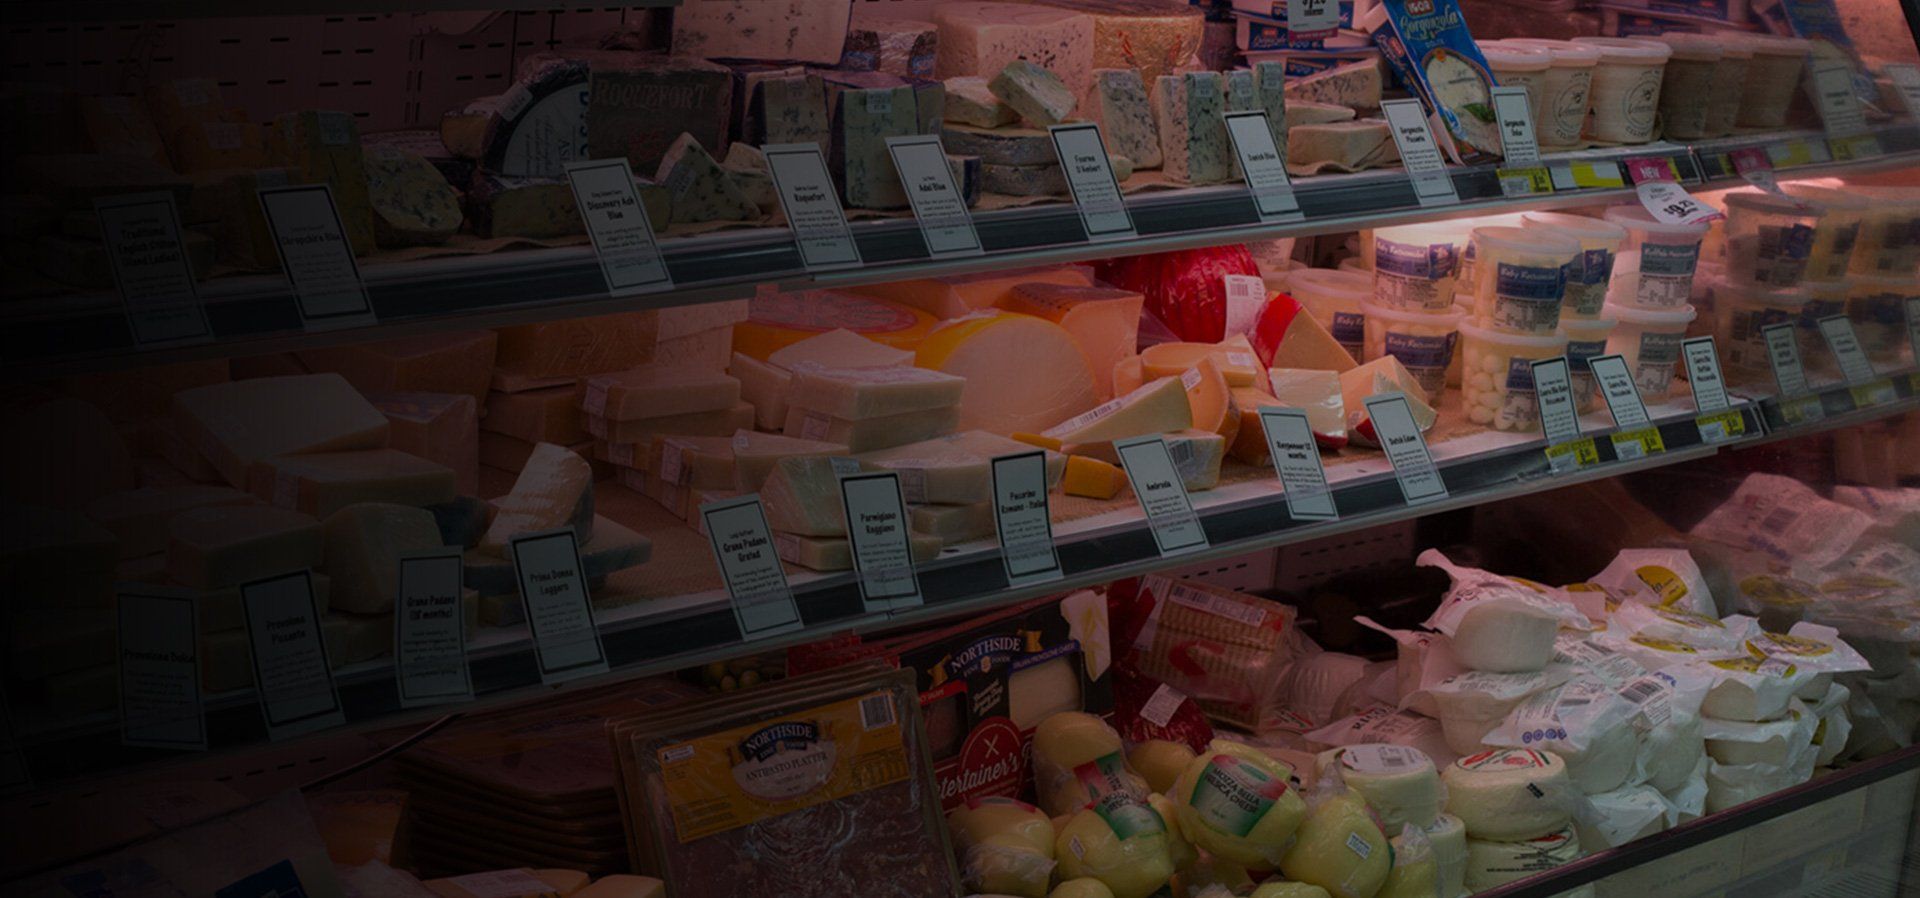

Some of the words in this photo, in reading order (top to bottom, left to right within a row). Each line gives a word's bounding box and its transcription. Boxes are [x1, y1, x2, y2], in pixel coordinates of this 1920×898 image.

[1407, 0, 1433, 14] IGOR
[1401, 5, 1459, 39] Gorgonzola
[593, 80, 705, 111] ROQUEFORT
[1641, 167, 1660, 179] NEW
[933, 183, 946, 191] Blue
[587, 200, 620, 210] Discovery
[622, 196, 634, 206] Ash
[794, 194, 825, 204] Roquefort
[607, 211, 623, 220] Blue
[1288, 452, 1307, 460] months
[1010, 489, 1036, 499] Pecorino
[1001, 504, 1024, 514] Romano
[861, 512, 897, 524] Parmigiano
[866, 524, 895, 535] Reggiano
[723, 541, 743, 554] Grana
[743, 537, 767, 549] Padano
[738, 551, 761, 562] Grated
[530, 572, 550, 582] Prima
[551, 569, 573, 579] Donna
[407, 595, 429, 607] Grana
[430, 595, 456, 606] Padano
[422, 607, 453, 620] months)
[266, 616, 306, 631] Provolone
[124, 648, 170, 663] Provolone
[951, 637, 1021, 673] NORTHSIDE
[745, 725, 813, 751] NORTHSIDE
[745, 761, 791, 782] ANTIPASTO
[791, 751, 828, 768] PLATTER
[936, 753, 1019, 800] tertainer's
